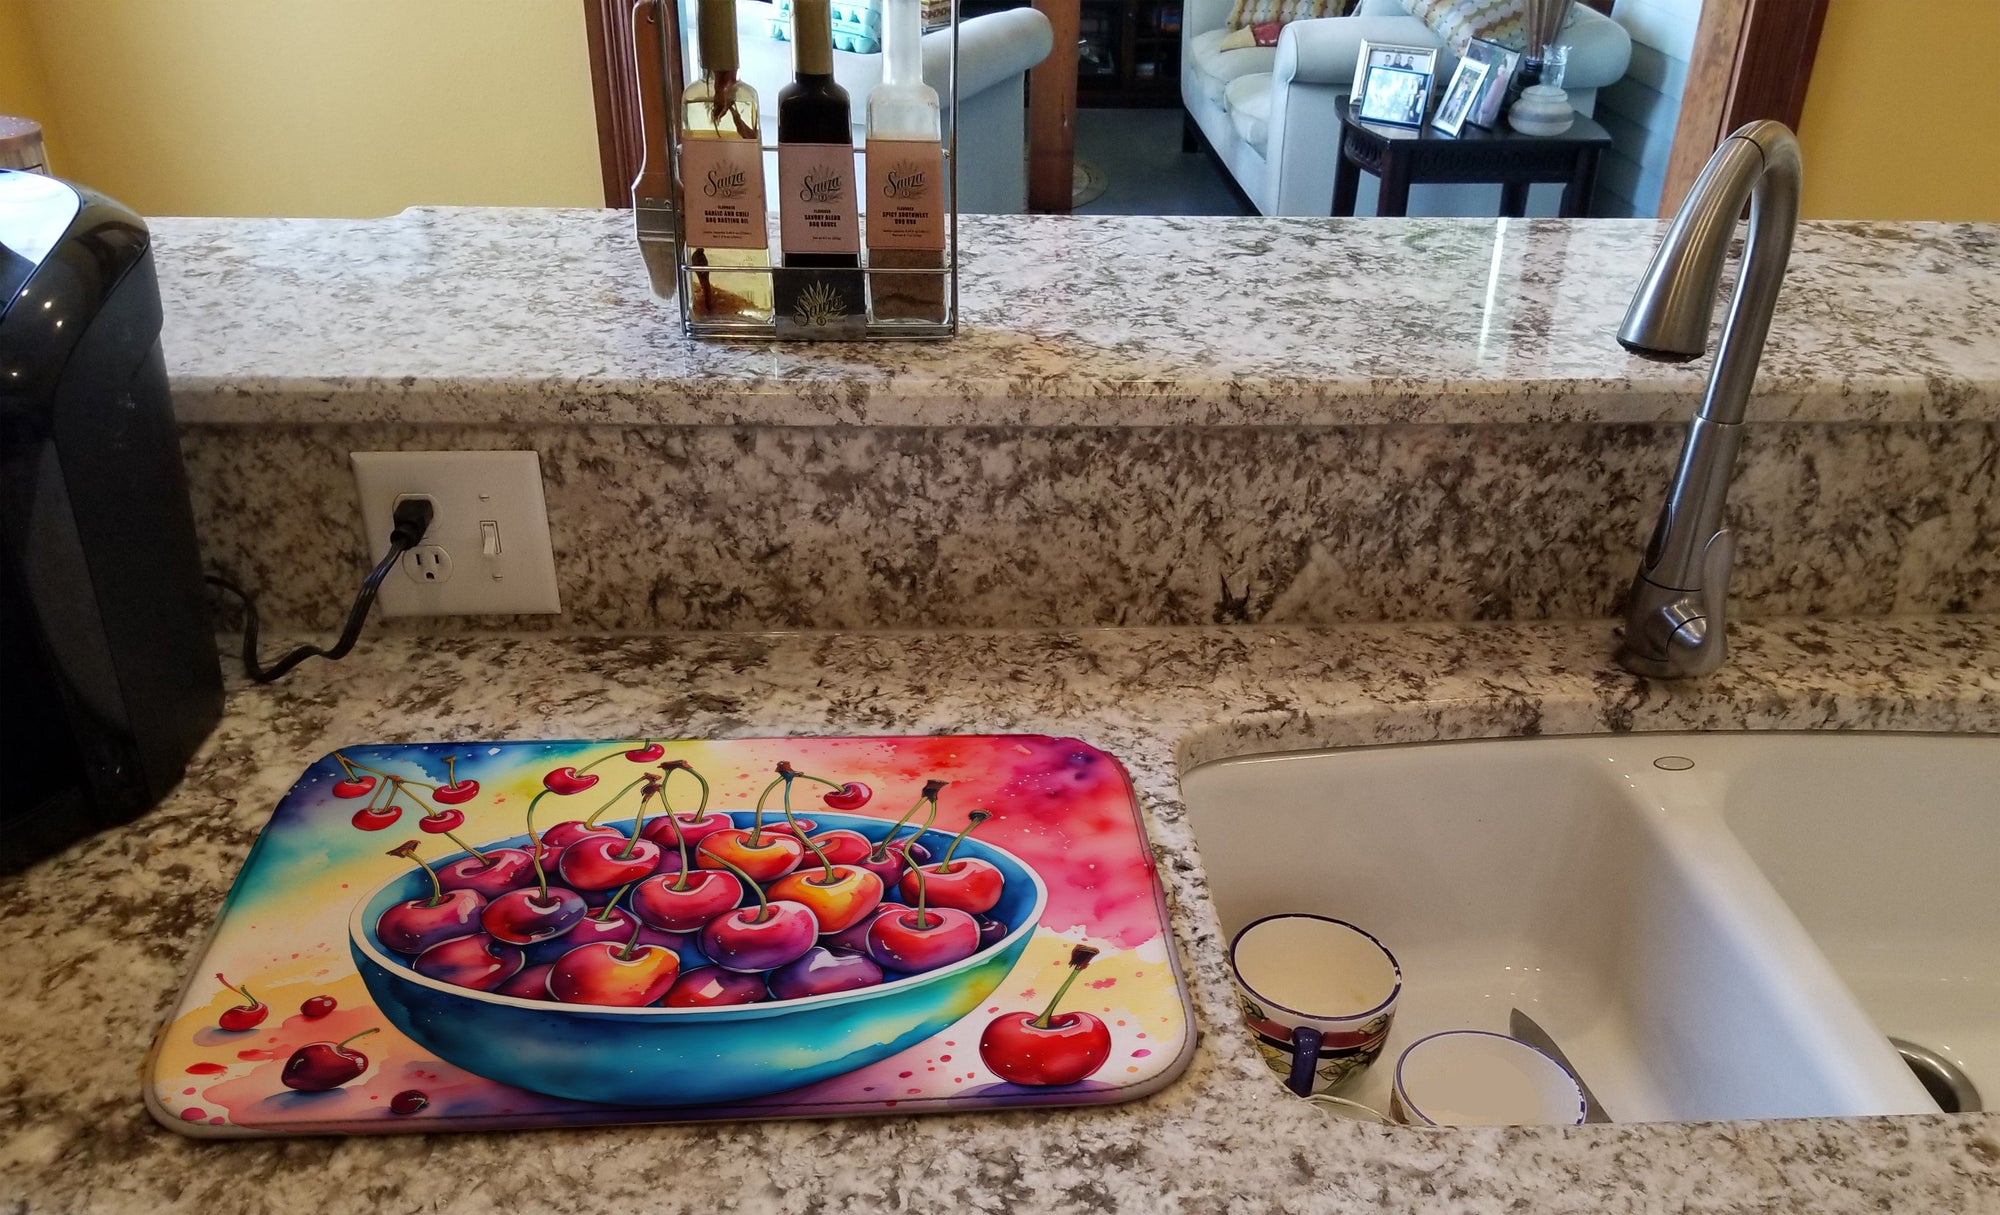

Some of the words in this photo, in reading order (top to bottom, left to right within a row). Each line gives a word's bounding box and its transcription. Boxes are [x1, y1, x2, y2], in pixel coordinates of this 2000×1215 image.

[703, 170, 745, 197] Sauza
[800, 175, 841, 202] Sauza
[883, 170, 924, 198] Sauza
